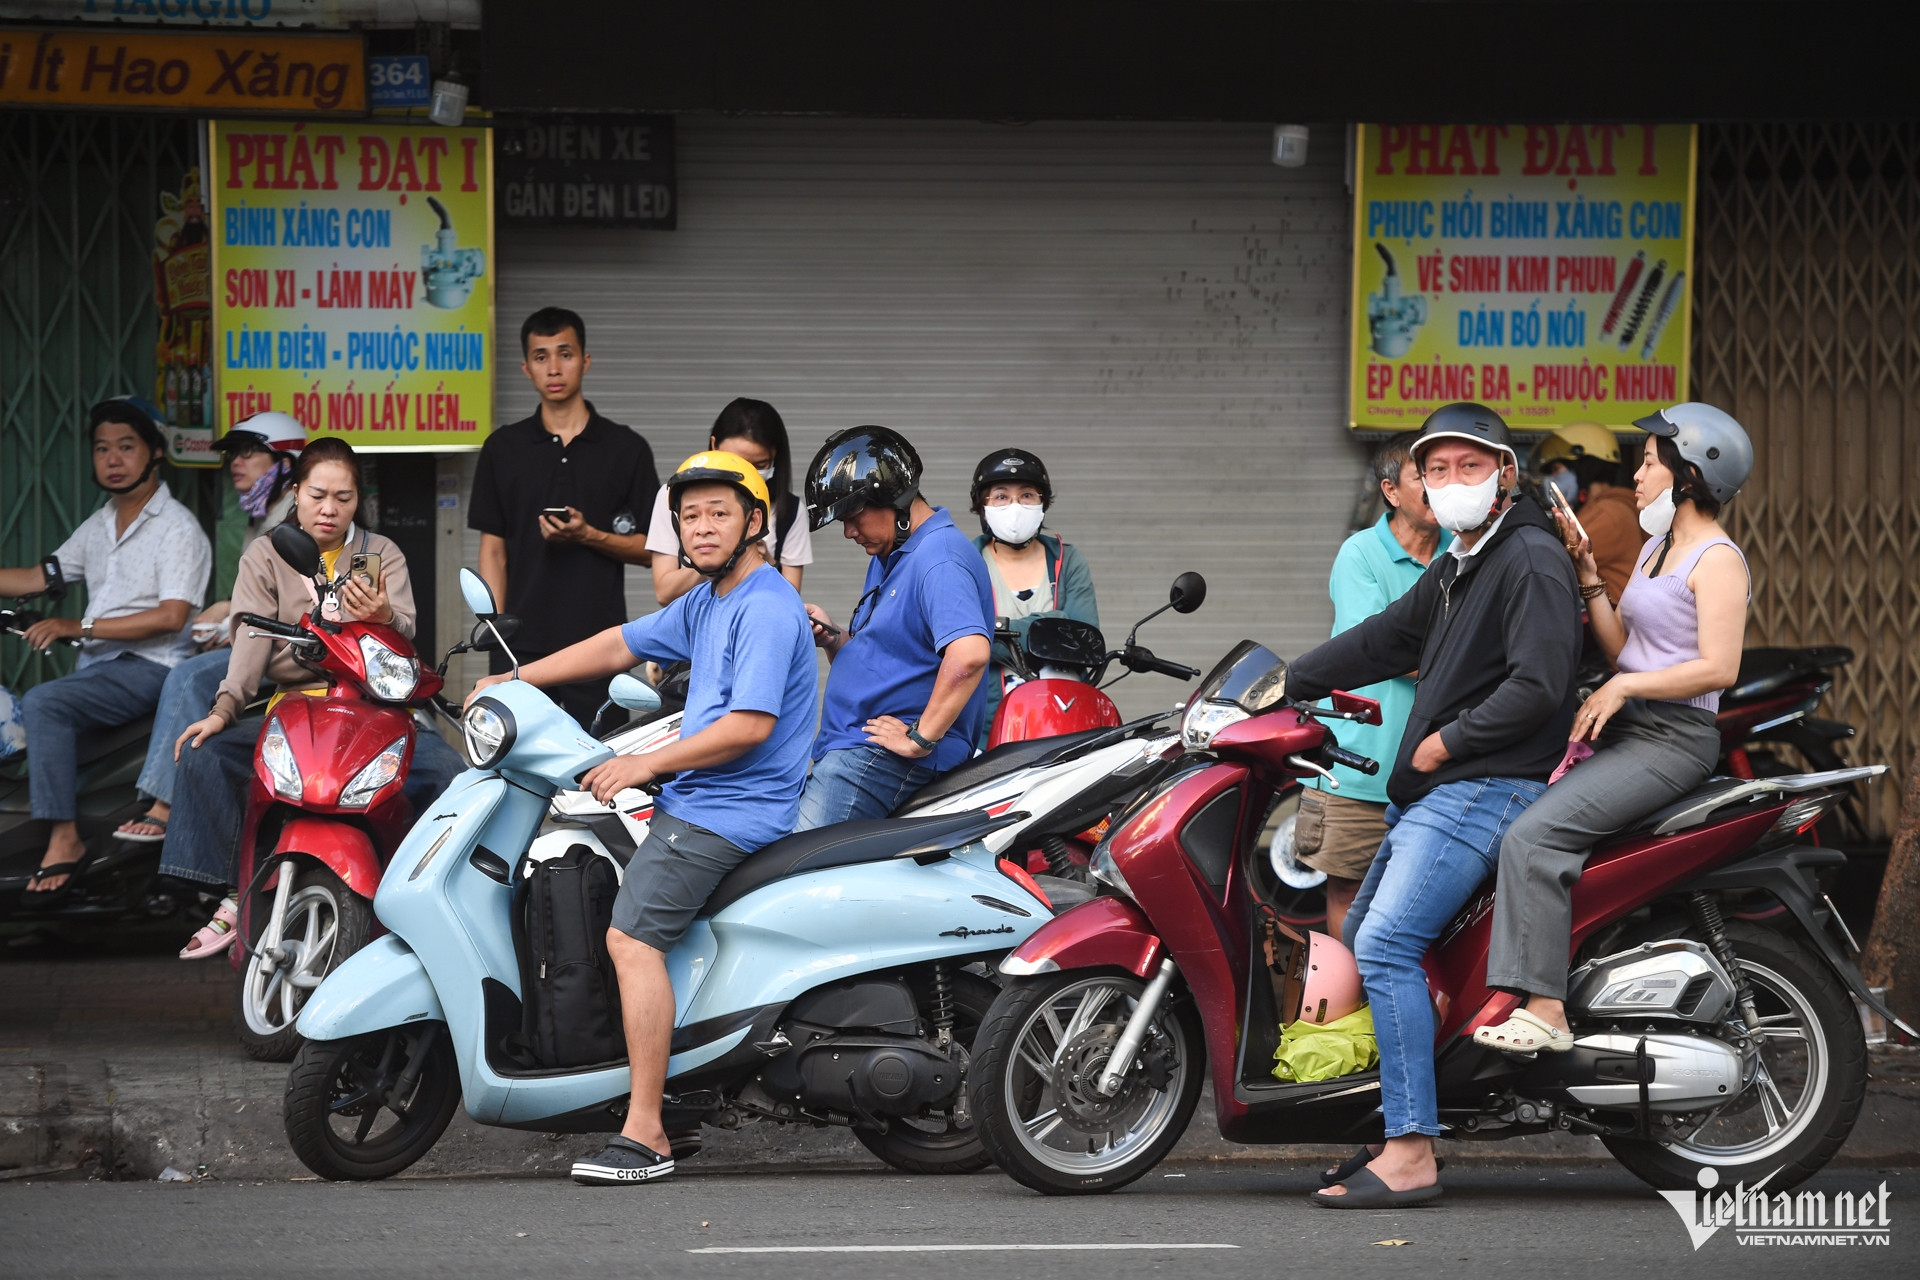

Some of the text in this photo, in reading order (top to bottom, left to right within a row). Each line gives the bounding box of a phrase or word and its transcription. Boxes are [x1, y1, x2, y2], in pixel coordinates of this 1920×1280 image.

[28, 32, 65, 92] Ít
[82, 46, 190, 95] Hao
[207, 49, 348, 109] Xăng
[369, 62, 424, 86] 364
[226, 122, 478, 206] PHÁT ĐẠT I
[524, 116, 651, 167] ĐIỆN XE
[1521, 124, 1626, 191] ĐẠT
[1639, 124, 1658, 175] I
[505, 167, 671, 219] GẮN ĐÈN LED
[225, 199, 391, 248] BÌNH XĂNG CON
[1368, 200, 1434, 246] PHỤC
[1490, 193, 1549, 239] BÌNH
[1555, 194, 1622, 239] XĂNG
[1630, 201, 1682, 240] CON
[274, 269, 296, 308] XI
[317, 262, 362, 309] LÀM
[368, 262, 416, 310] MÁY
[1417, 248, 1617, 301] VỆ SINH KIM PHUN
[226, 323, 272, 369] LÀM
[278, 323, 327, 378] ĐIỆN
[348, 324, 420, 379] PHUỘC
[425, 325, 483, 371] NHÚN
[293, 380, 322, 431] BỐ
[370, 380, 410, 431] LẤY
[1482, 365, 1511, 400] BA
[1533, 357, 1608, 411] PHUỘC
[1615, 358, 1676, 401] NHÚN
[184, 437, 214, 452] Castro
[327, 707, 355, 716] HONDA
[938, 923, 1016, 939] Grande
[1671, 1068, 1724, 1079] HONDA
[616, 1169, 648, 1180] crocs
